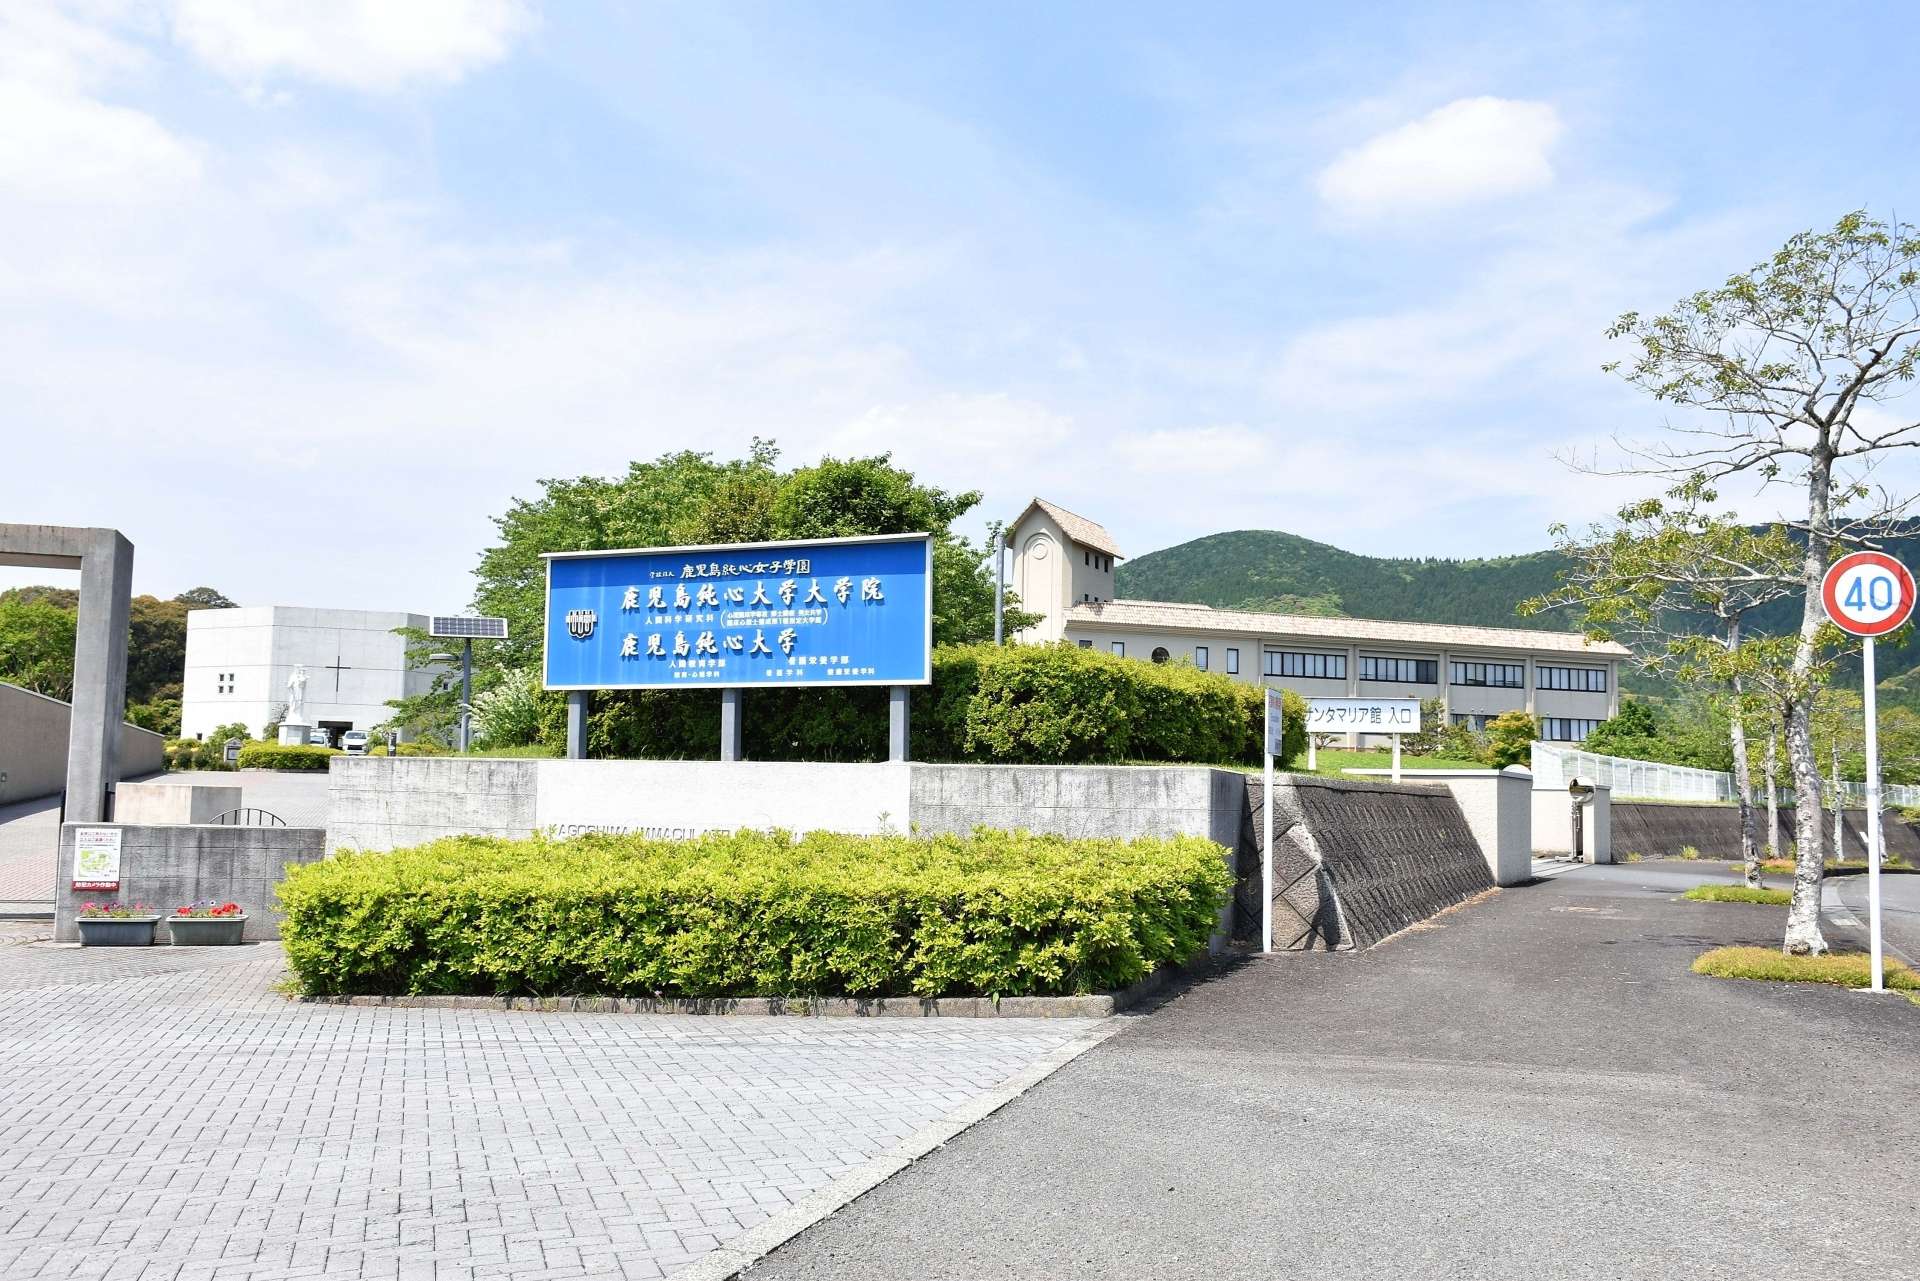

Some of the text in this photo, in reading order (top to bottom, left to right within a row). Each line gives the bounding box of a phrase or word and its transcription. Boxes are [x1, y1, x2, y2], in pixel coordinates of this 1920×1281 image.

[620, 577, 884, 609] 鹿児島純心大学大学院
[1844, 576, 1893, 611] 40
[619, 628, 798, 657] 鹿児島純心大学
[1388, 706, 1411, 724] 入口
